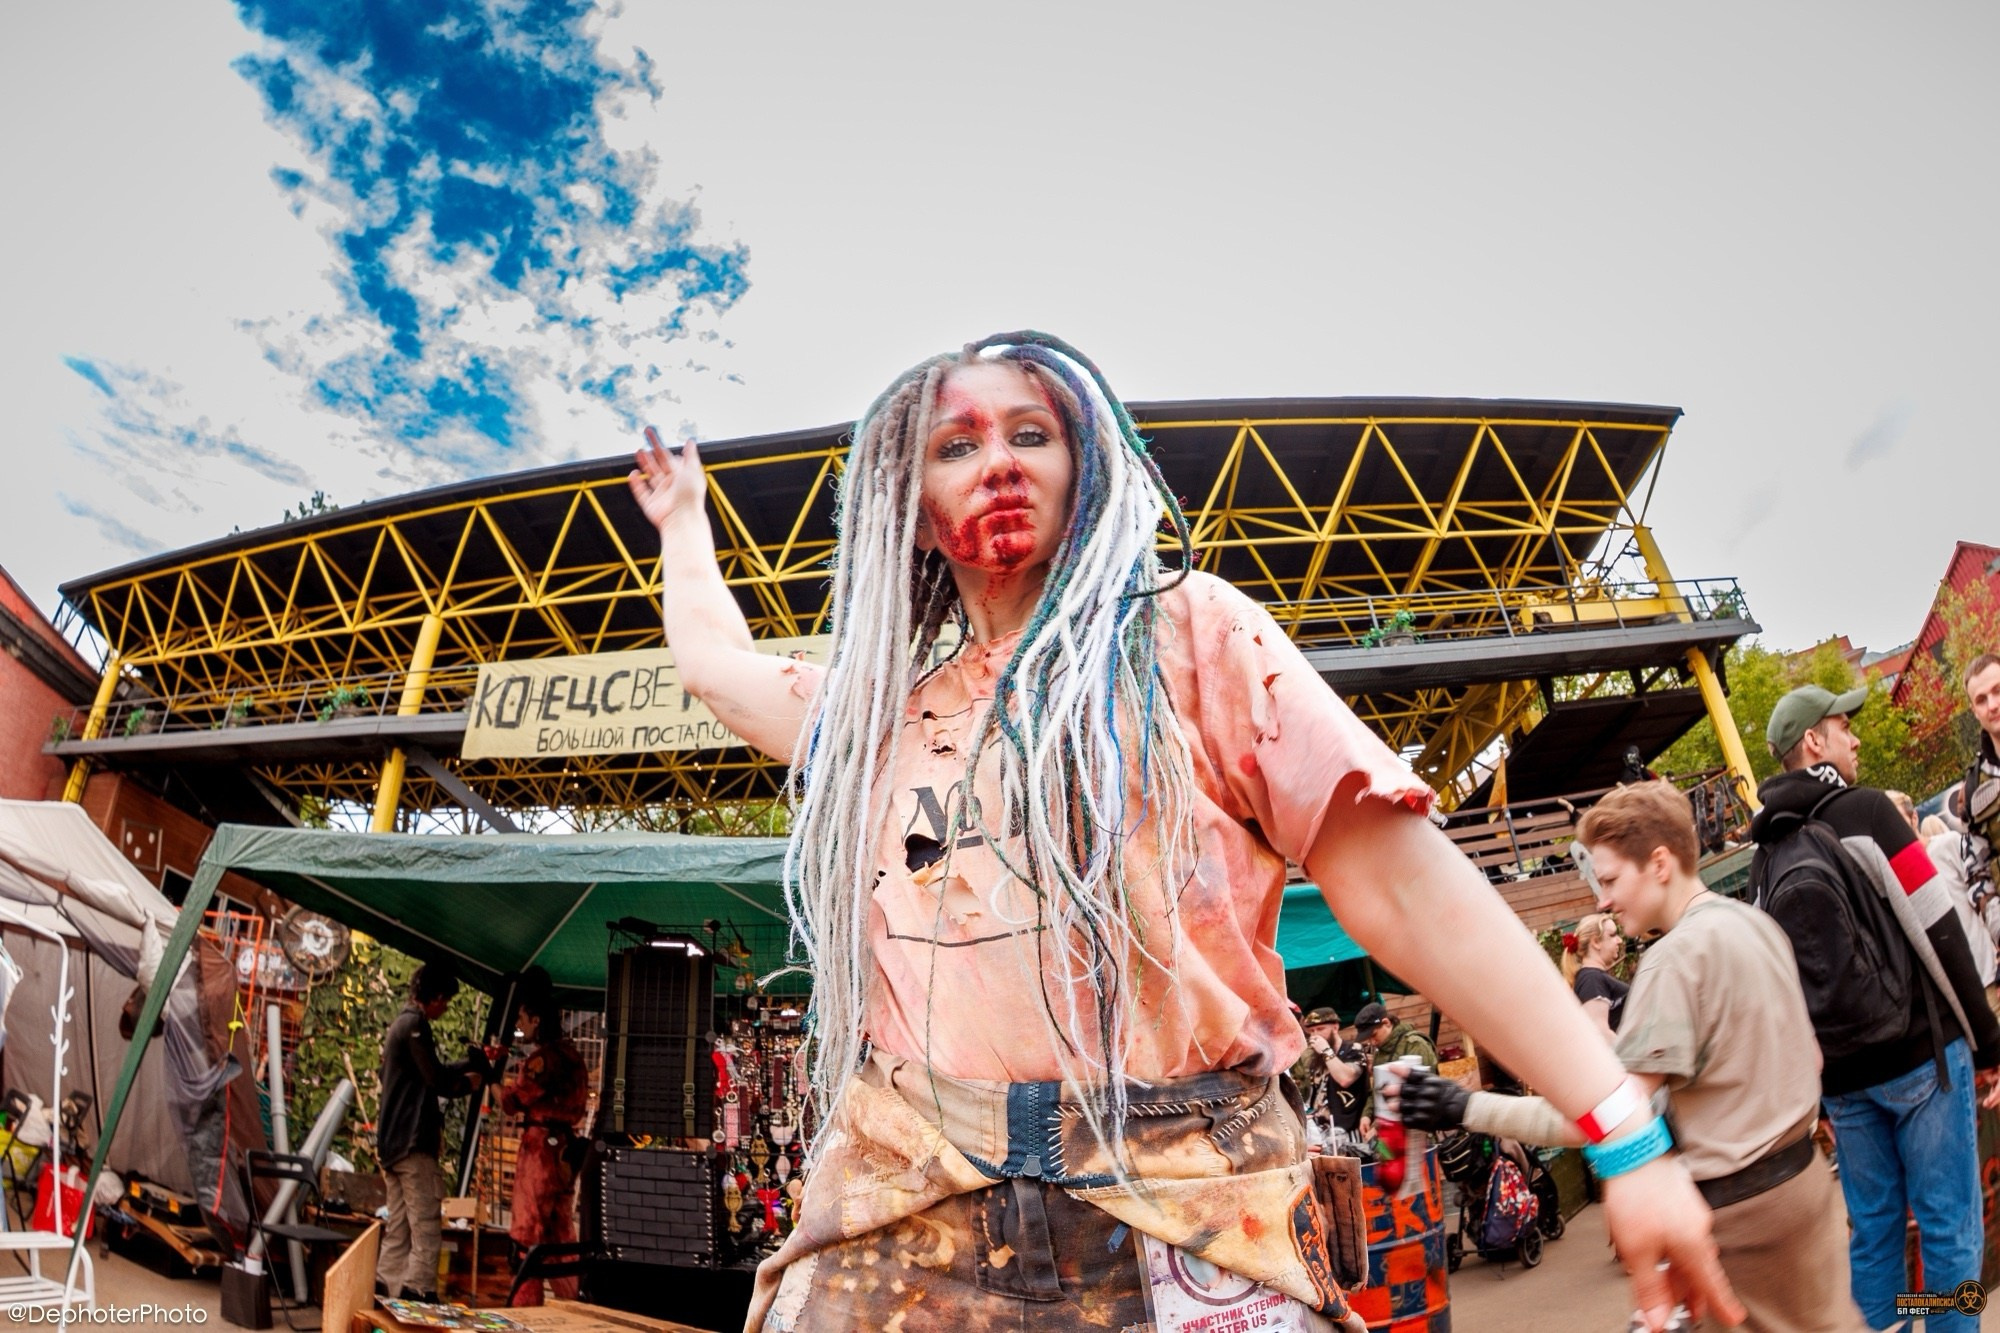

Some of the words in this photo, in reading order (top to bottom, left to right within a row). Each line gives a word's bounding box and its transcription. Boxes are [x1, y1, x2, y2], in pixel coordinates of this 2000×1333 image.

[536, 726, 625, 753] БОЛЬШОЙ
[1182, 1306, 1245, 1333] УЧАСТНИК
[1246, 1293, 1287, 1315] СТЕНДА
[1251, 1313, 1267, 1328] US
